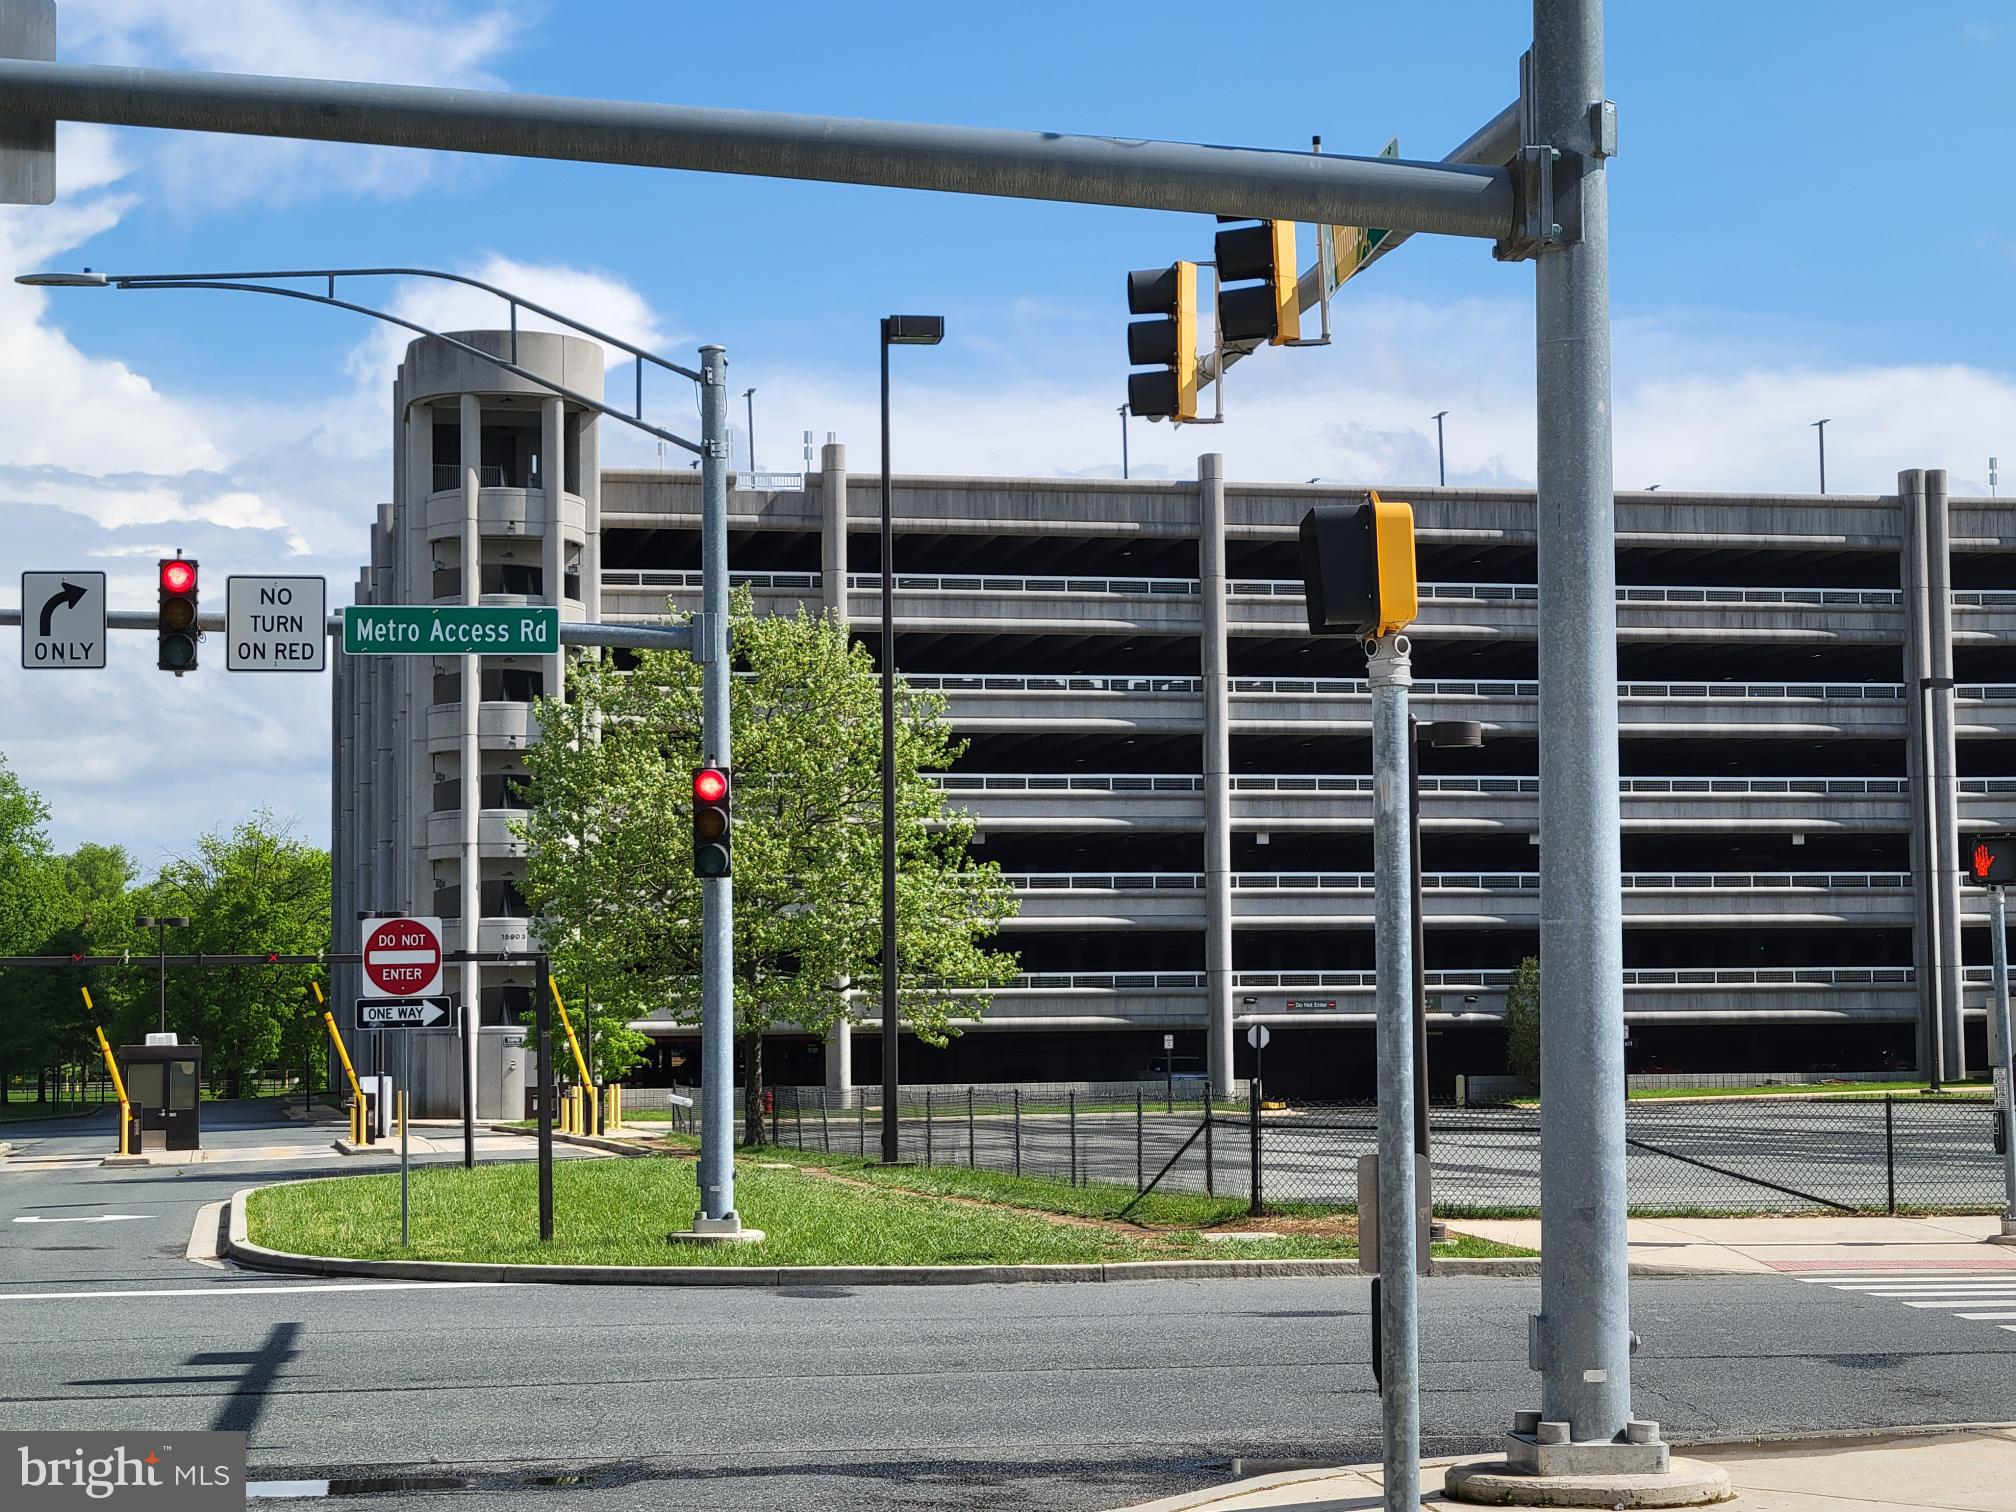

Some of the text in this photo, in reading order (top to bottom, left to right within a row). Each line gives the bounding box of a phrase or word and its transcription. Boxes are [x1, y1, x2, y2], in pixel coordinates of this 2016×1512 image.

[260, 587, 292, 605] NO
[250, 615, 303, 632] TURN
[357, 618, 547, 642] Metro Access Rd
[34, 642, 94, 660] ONLY
[238, 642, 314, 660] ON RED
[378, 934, 426, 946] DO NOT
[382, 968, 422, 980] ENTER
[368, 1007, 424, 1020] ONE WAY
